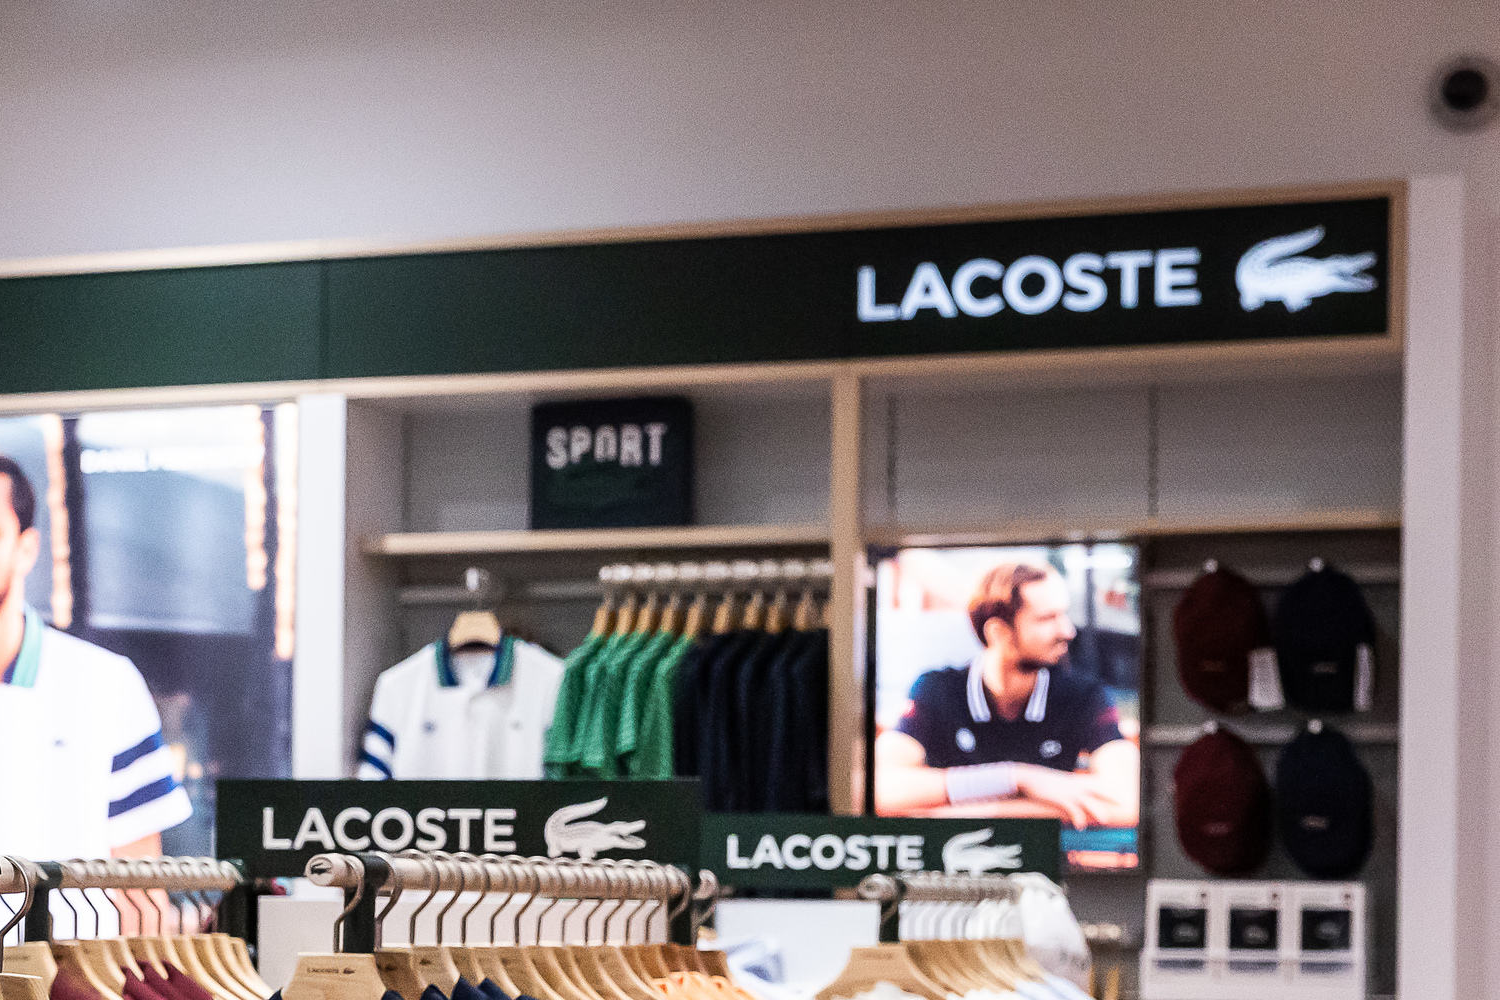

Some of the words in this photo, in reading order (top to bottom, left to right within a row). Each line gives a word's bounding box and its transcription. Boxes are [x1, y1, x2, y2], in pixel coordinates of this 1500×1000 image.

[856, 246, 1202, 323] LACOSTE
[262, 806, 517, 852] LACOSTE
[726, 833, 925, 871] LACOSTE
